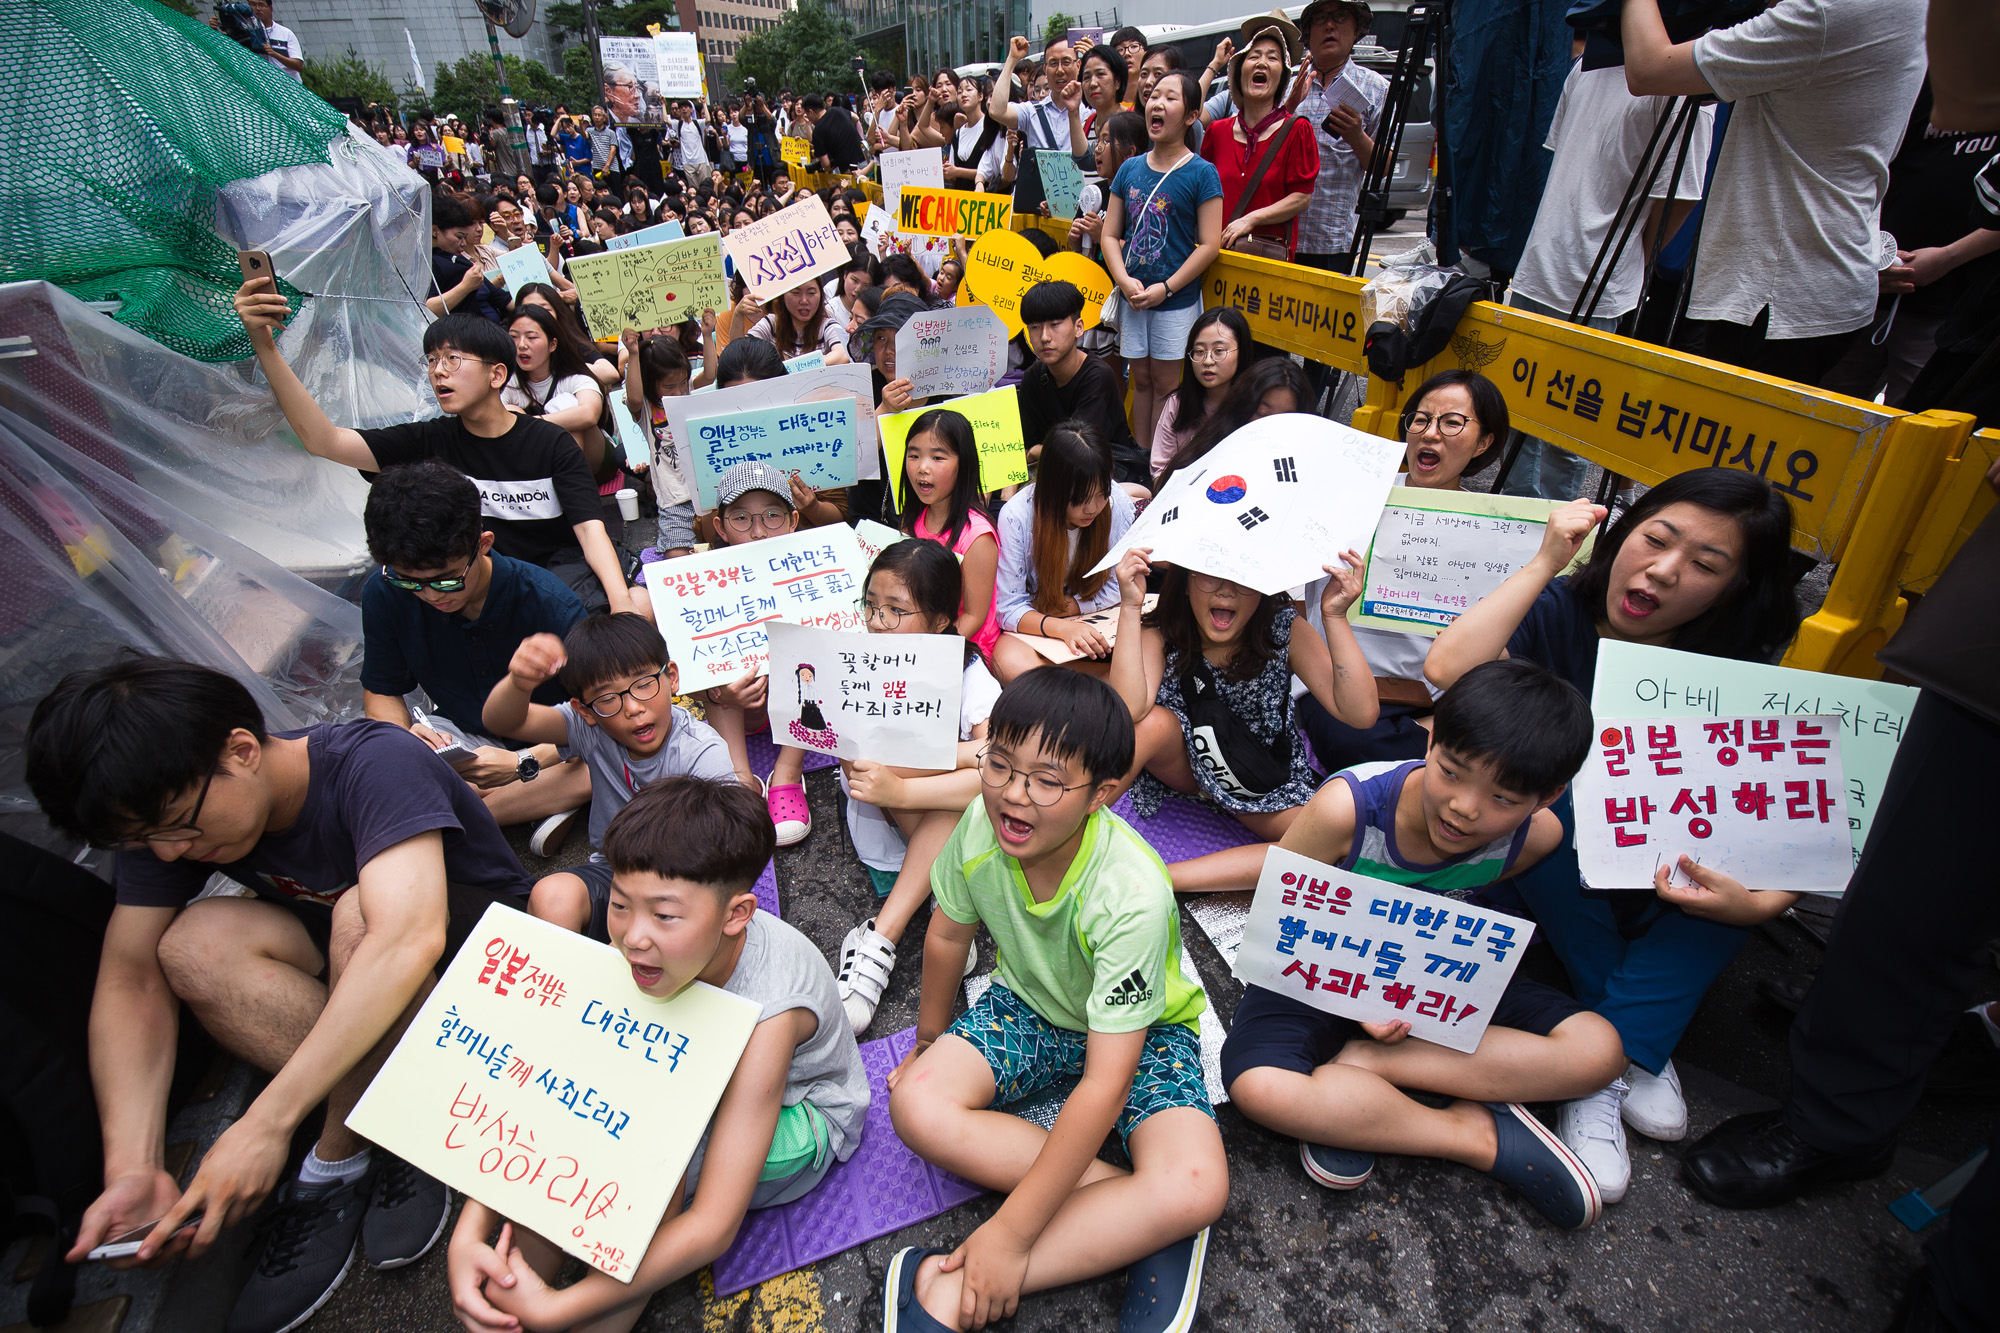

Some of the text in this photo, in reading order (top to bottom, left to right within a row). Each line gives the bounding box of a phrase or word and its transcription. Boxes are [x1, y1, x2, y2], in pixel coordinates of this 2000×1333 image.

[1953, 136, 1998, 155] YOU
[976, 250, 1014, 272] 나비의
[992, 294, 1016, 311] 우리의
[1214, 278, 1356, 340] 이 선을 넘지마시오
[700, 410, 847, 453] 일본정부는 대한민국
[1512, 357, 1819, 503] 이 선을 넘지마시오
[491, 489, 550, 503] CHANDÔN
[1436, 516, 1481, 530] 세상에는
[1491, 522, 1510, 534] 그런
[1516, 525, 1527, 534] 일
[663, 545, 837, 597] 일본정부는 대한민국
[1396, 555, 1407, 563] 내
[1416, 555, 1439, 567] 잘못도
[1377, 584, 1468, 608] 할머니의 수요일을
[680, 595, 776, 633] 할머니들께
[707, 657, 737, 676] 우리도
[839, 680, 907, 699] 들께 일본
[1635, 677, 1719, 716] 아베
[1604, 779, 1836, 848] 반성하라
[1280, 871, 1516, 963] 일본은 대한민국
[478, 937, 690, 1074] 일본정부는 대한민국
[1105, 989, 1153, 1006] adidas
[435, 1005, 631, 1141] 할머니들께 사죄드리고
